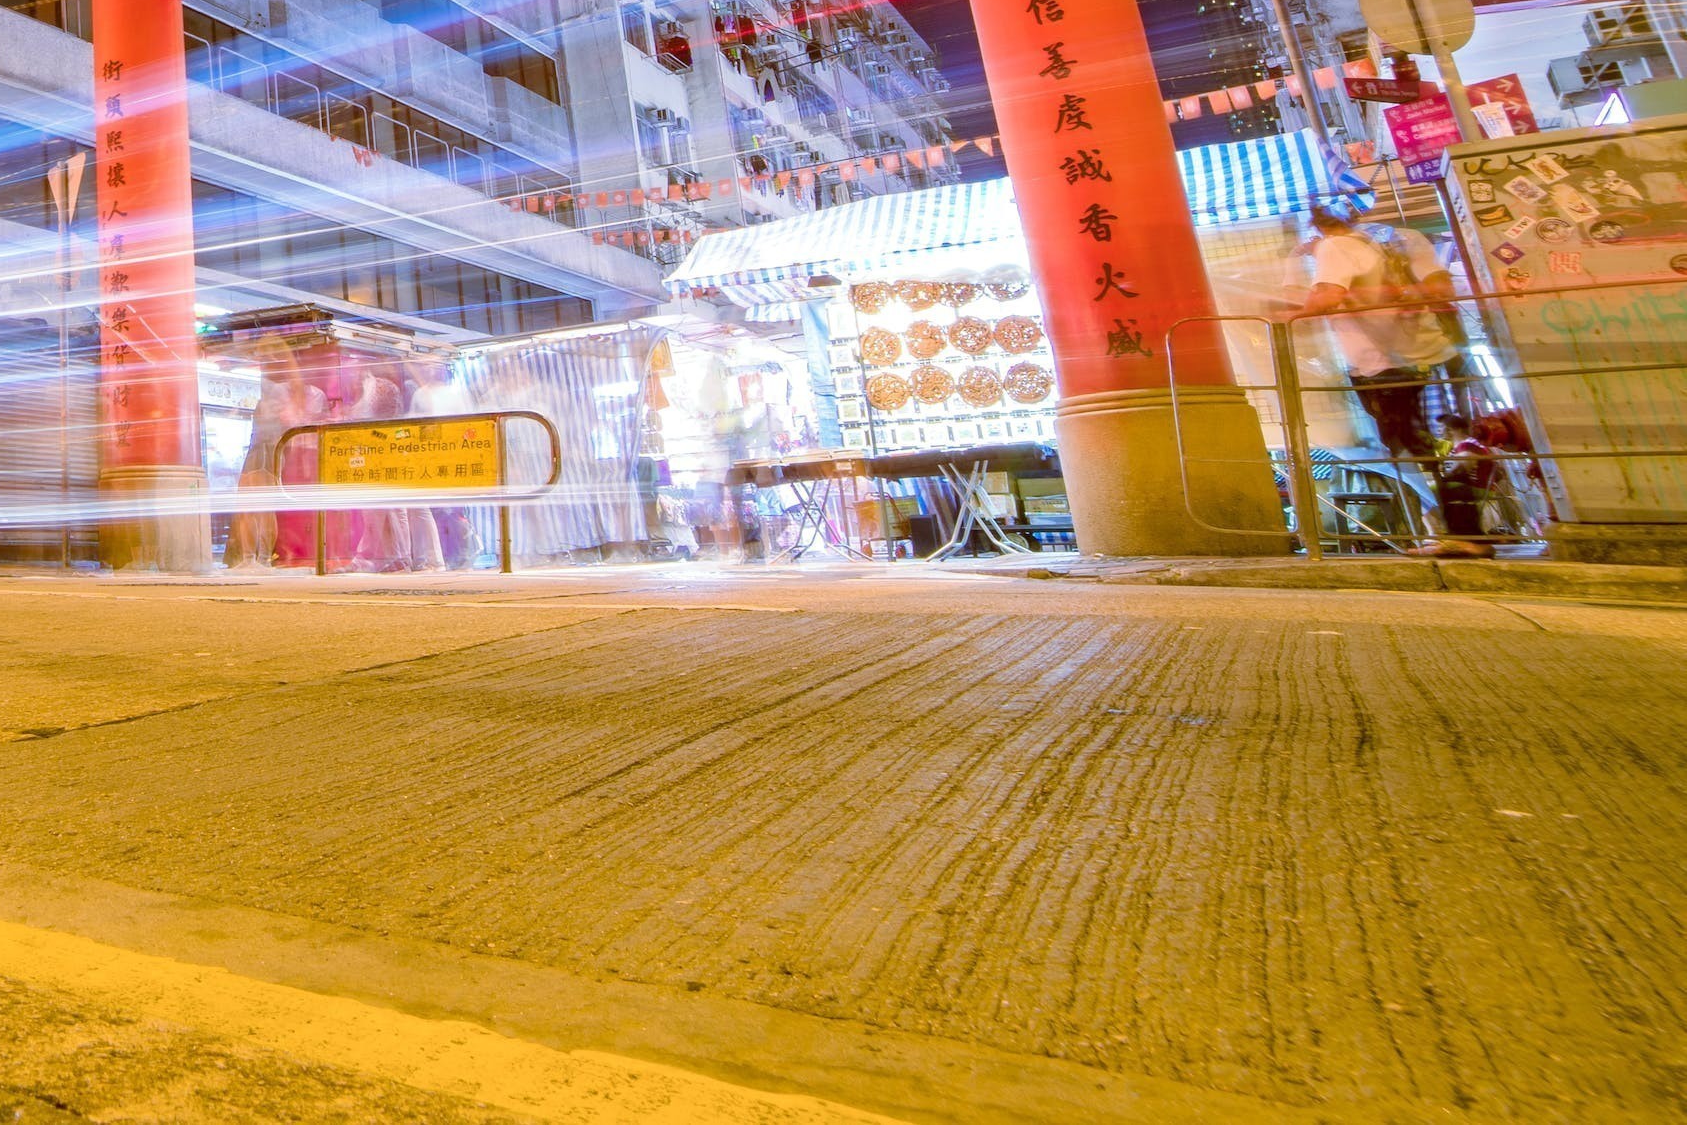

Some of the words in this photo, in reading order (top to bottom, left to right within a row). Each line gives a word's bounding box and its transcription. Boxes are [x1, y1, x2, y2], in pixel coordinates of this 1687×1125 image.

[329, 445, 384, 457] Part-time
[389, 440, 456, 455] Pedestrian
[461, 438, 491, 449] Area
[336, 462, 485, 483] 部份時間行人專用區
